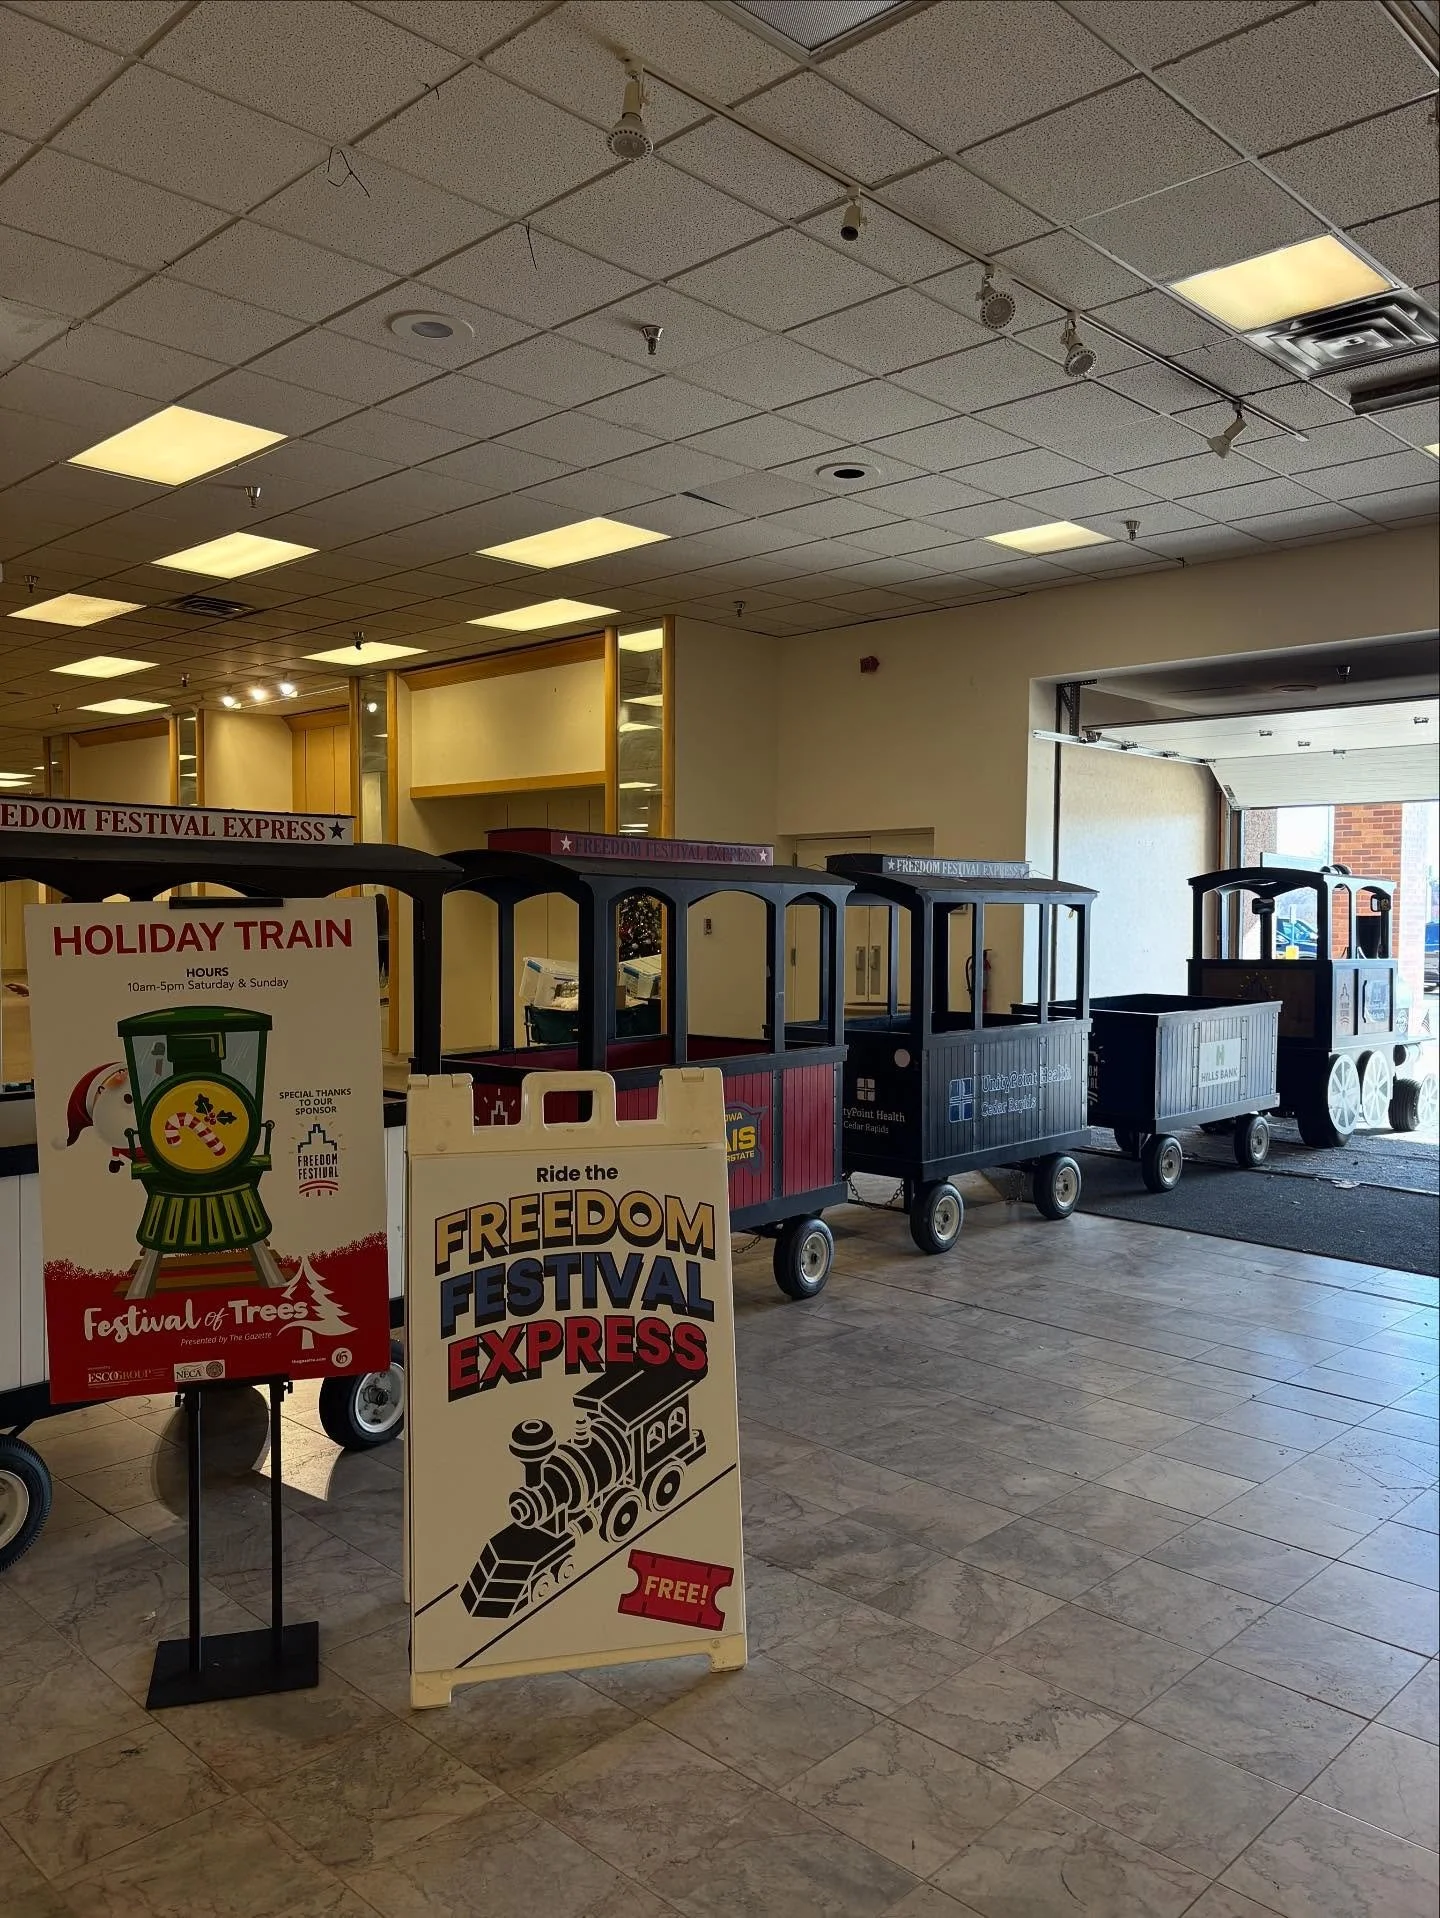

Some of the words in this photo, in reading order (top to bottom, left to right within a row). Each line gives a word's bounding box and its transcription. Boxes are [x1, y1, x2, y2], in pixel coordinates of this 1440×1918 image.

[95, 809, 216, 837] FESTIVAL
[223, 816, 327, 842] EXPRESS
[575, 838, 641, 857] FREEDOM
[646, 842, 703, 861] FESTIVAL
[706, 845, 759, 864] EXPRESS
[896, 859, 940, 875] FREEDOM
[942, 861, 980, 877] FESTIVAL
[983, 863, 1019, 878] EXPRESS
[53, 921, 224, 956] HOLIDAY
[233, 918, 353, 951] TRAIN
[186, 966, 229, 978] HOURS
[127, 981, 185, 993] 10am-5pm
[187, 979, 235, 992] Saturday
[238, 979, 247, 989] &
[250, 977, 289, 989] Sunday
[981, 1070, 1038, 1094] UnityPoint
[1039, 1063, 1073, 1085] Health
[1201, 1070, 1219, 1082] HILLS
[1220, 1067, 1238, 1080] BANK
[279, 1091, 314, 1100] SPECIAL
[316, 1088, 352, 1097] THANKS
[299, 1099, 311, 1107] TO
[313, 1098, 333, 1106] OUR
[295, 1106, 337, 1116] SPONSOR
[981, 1098, 1008, 1117] Cedar
[1008, 1093, 1037, 1114] Rapids
[876, 1109, 905, 1123] Health
[843, 1120, 864, 1131] Cedar
[865, 1123, 889, 1135] Rapids
[297, 1152, 339, 1168] FREEDOM
[298, 1166, 339, 1180] FESTIVAL
[536, 1165, 581, 1183] Ride
[585, 1164, 619, 1181] the
[434, 1189, 716, 1277] FREEDOM
[440, 1251, 715, 1340] FESTIVAL
[84, 1299, 201, 1343] Festival
[205, 1307, 229, 1331] of
[228, 1300, 308, 1324] Trees
[180, 1335, 217, 1347] Presented
[218, 1335, 228, 1344] by
[244, 1332, 273, 1341] Gazette
[448, 1315, 709, 1403] EXPRESS
[176, 1369, 202, 1380] NECA
[644, 1575, 709, 1606] FREE!
